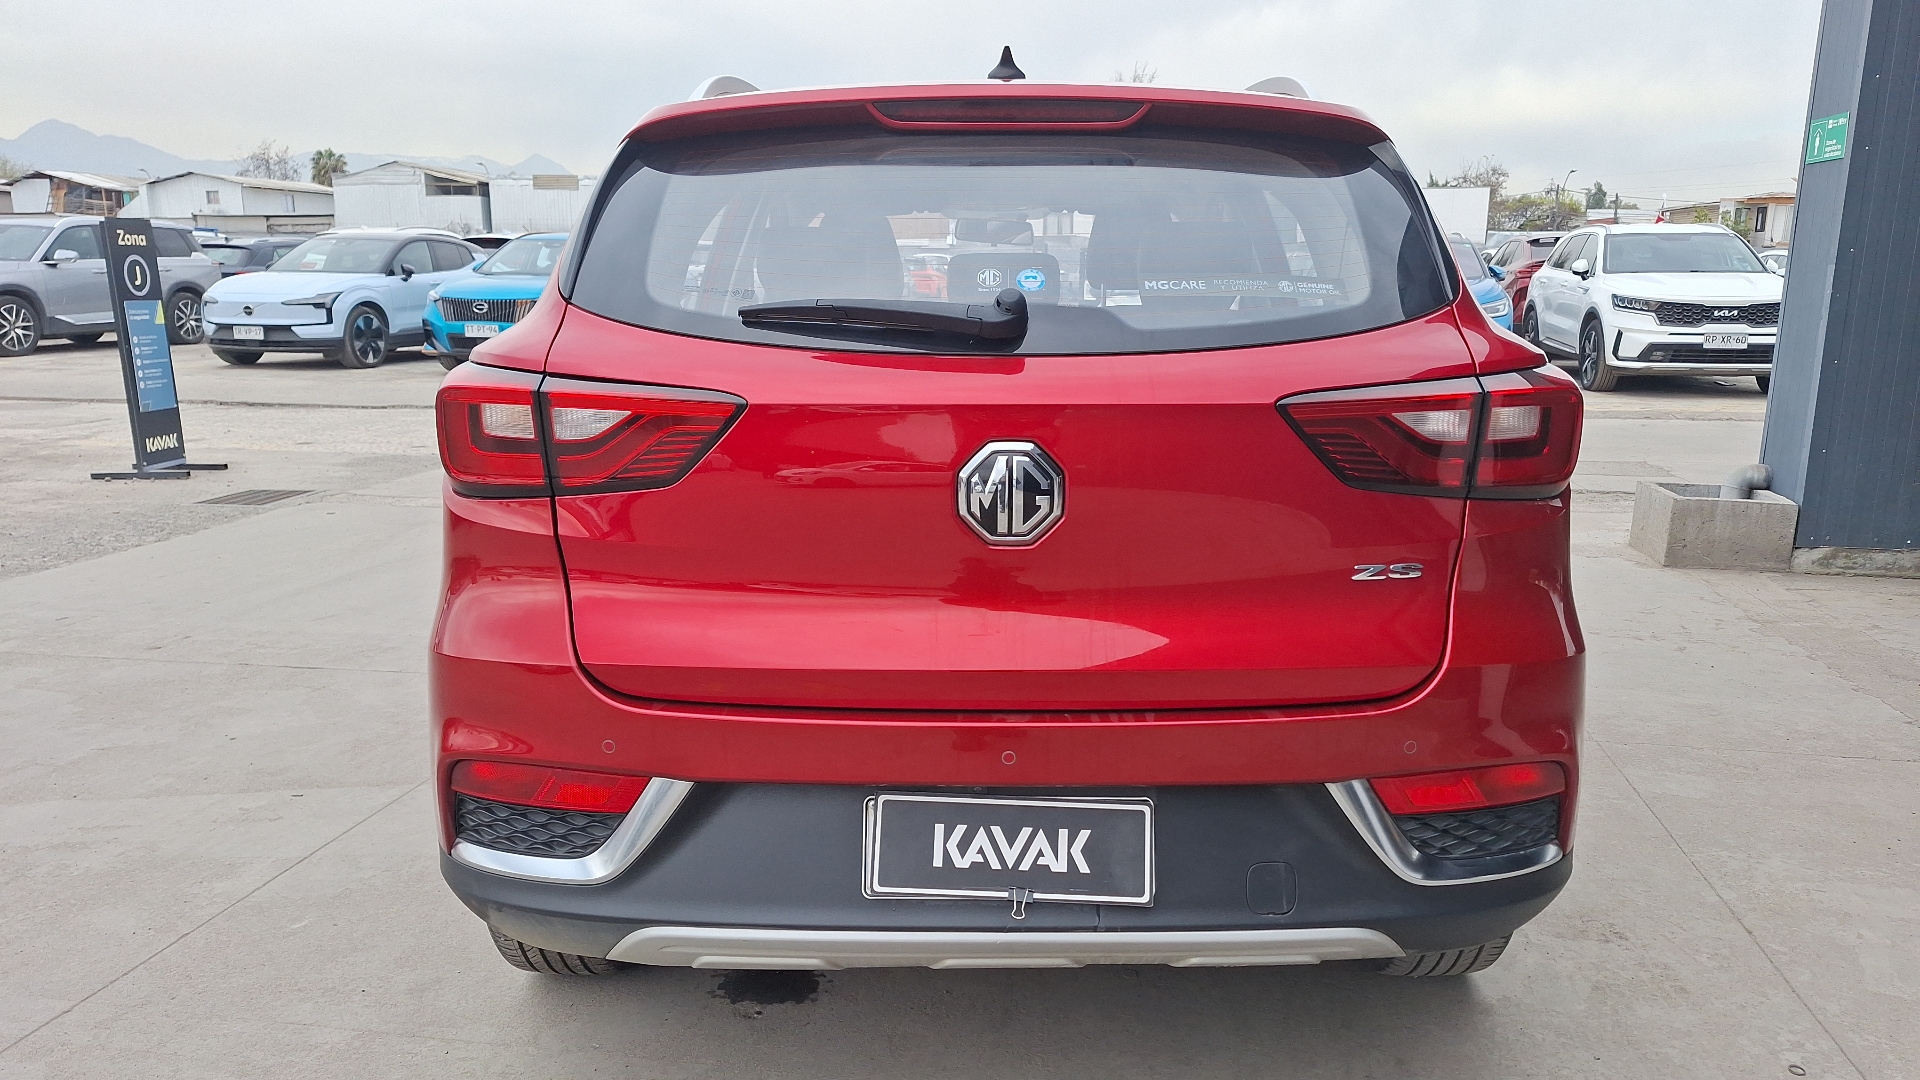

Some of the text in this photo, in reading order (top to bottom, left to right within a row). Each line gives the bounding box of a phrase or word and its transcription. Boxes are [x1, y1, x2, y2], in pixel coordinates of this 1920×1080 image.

[116, 229, 147, 246] Zona
[978, 268, 1002, 287] MG
[1144, 280, 1207, 290] MGCARE
[1297, 282, 1335, 290] GENUINE
[1299, 287, 1328, 295] MOTOR
[145, 432, 179, 453] KAVAK
[967, 452, 1053, 537] MG
[1350, 562, 1424, 581] ZS
[932, 822, 1092, 875] KAVAK
